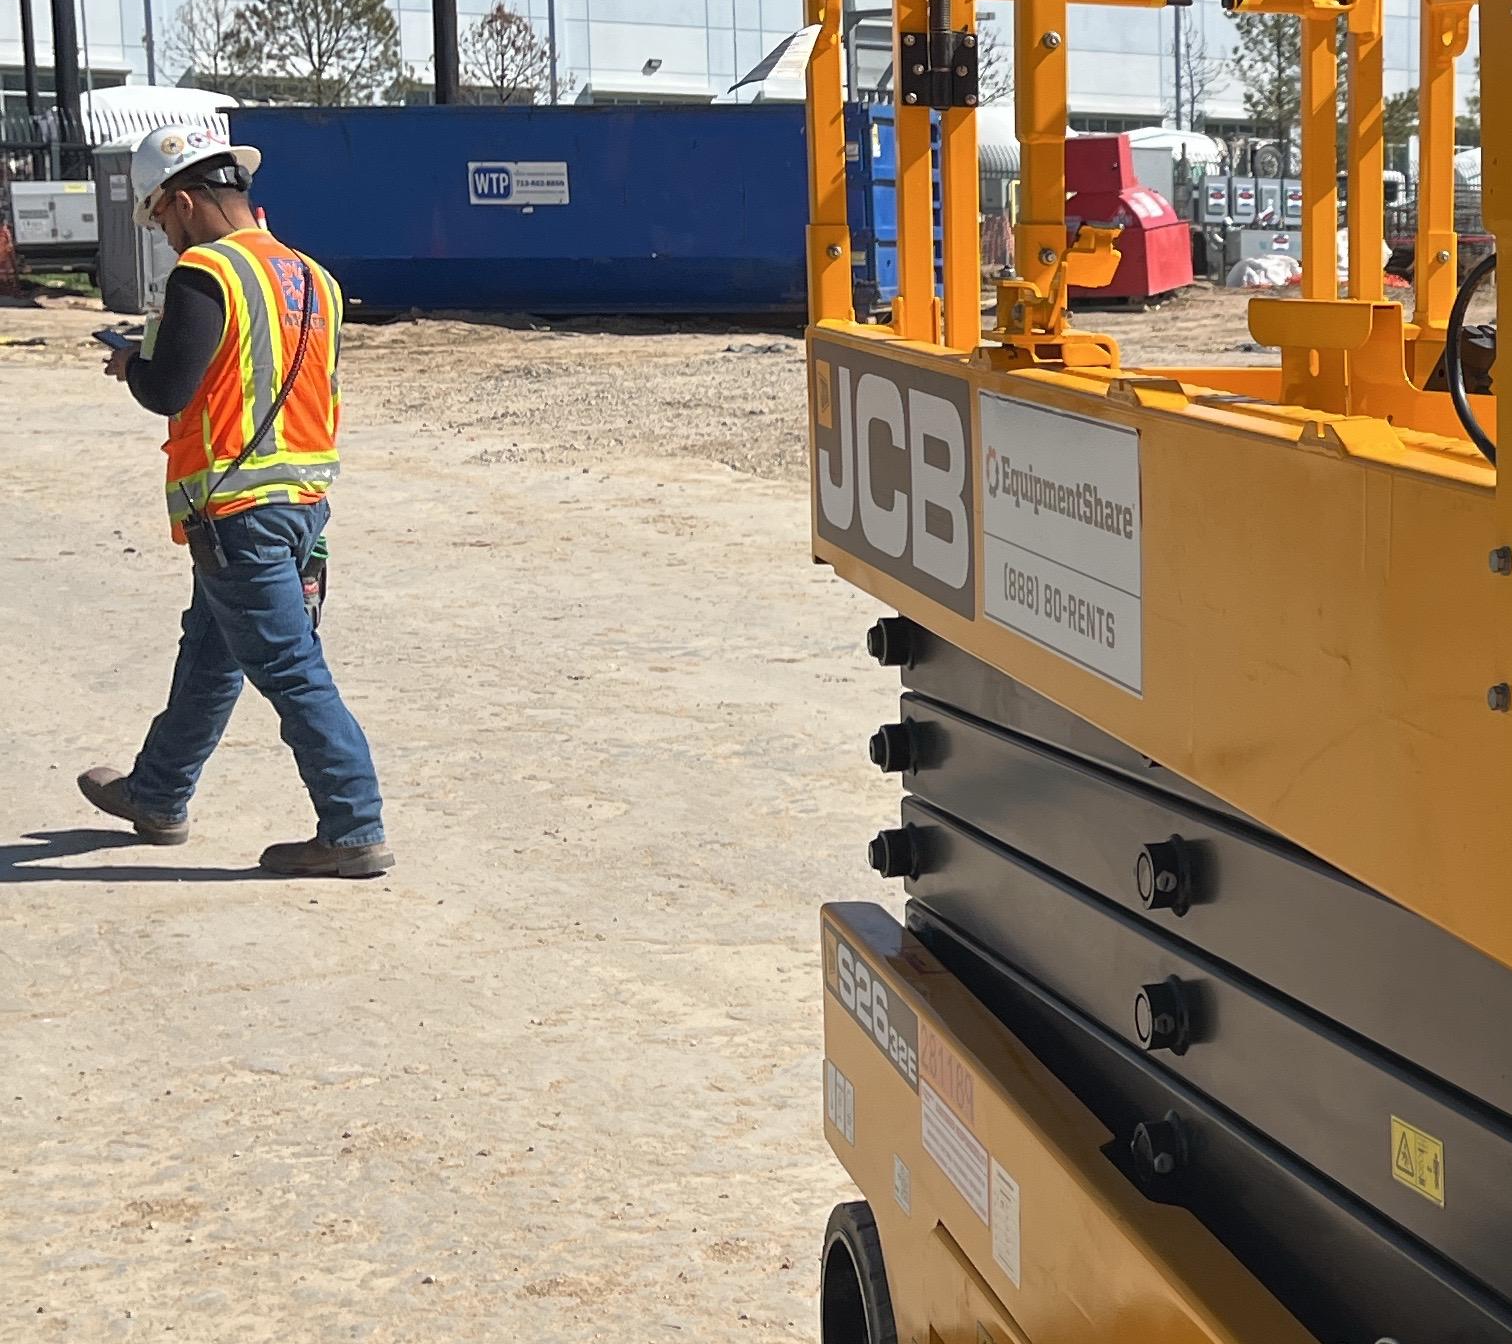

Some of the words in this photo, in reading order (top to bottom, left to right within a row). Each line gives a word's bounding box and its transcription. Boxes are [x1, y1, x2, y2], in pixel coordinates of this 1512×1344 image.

[474, 172, 509, 195] WTP
[818, 366, 970, 590] JCB
[1000, 455, 1134, 540] EquipmentShare
[1003, 561, 1040, 617] (888)
[1044, 582, 1116, 649] 80-RENTS
